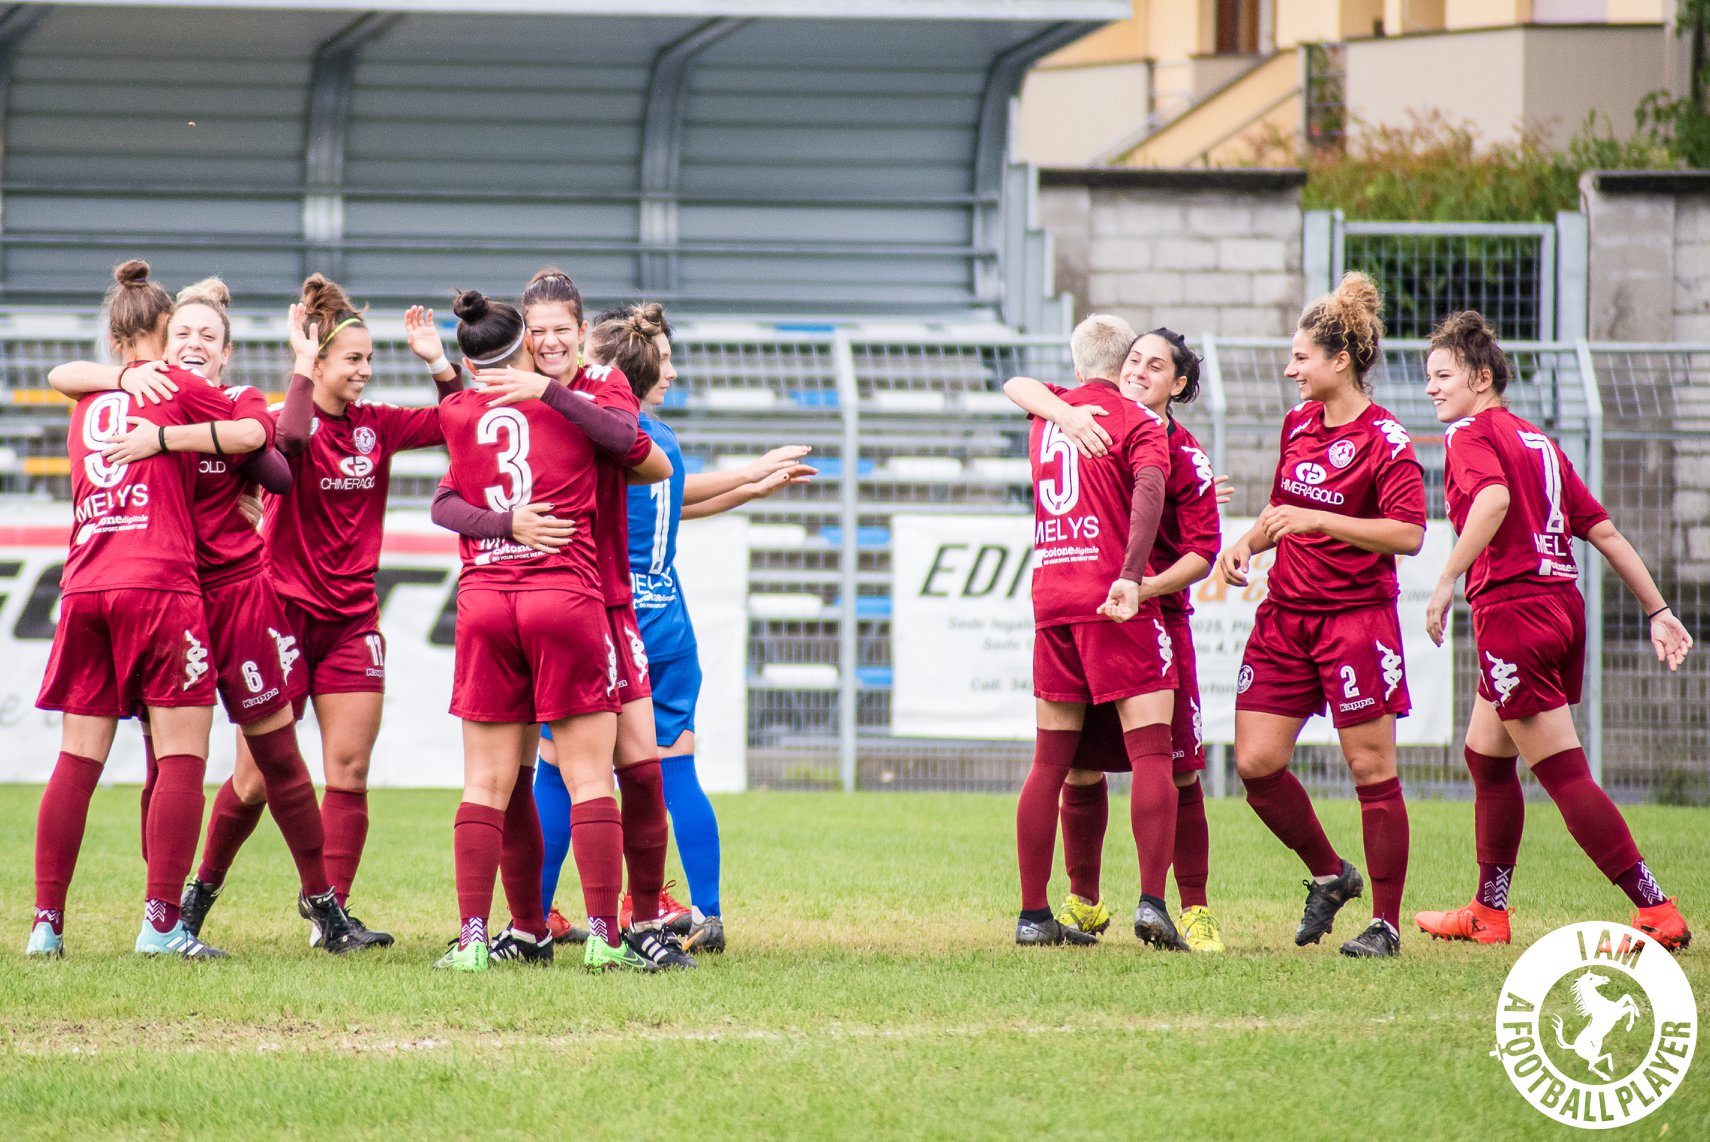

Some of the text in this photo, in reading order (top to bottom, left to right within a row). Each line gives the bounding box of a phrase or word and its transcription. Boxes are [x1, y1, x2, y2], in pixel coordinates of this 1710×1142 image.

[83, 391, 130, 488] 9
[477, 407, 532, 513] 3
[1039, 420, 1080, 516] 5
[1517, 430, 1564, 533] 7
[650, 478, 670, 575] 1
[918, 544, 1034, 599] EDI
[242, 660, 264, 693] 6
[243, 688, 280, 709] Kappa
[1340, 665, 1360, 699] 2
[1340, 697, 1375, 712] Kappa
